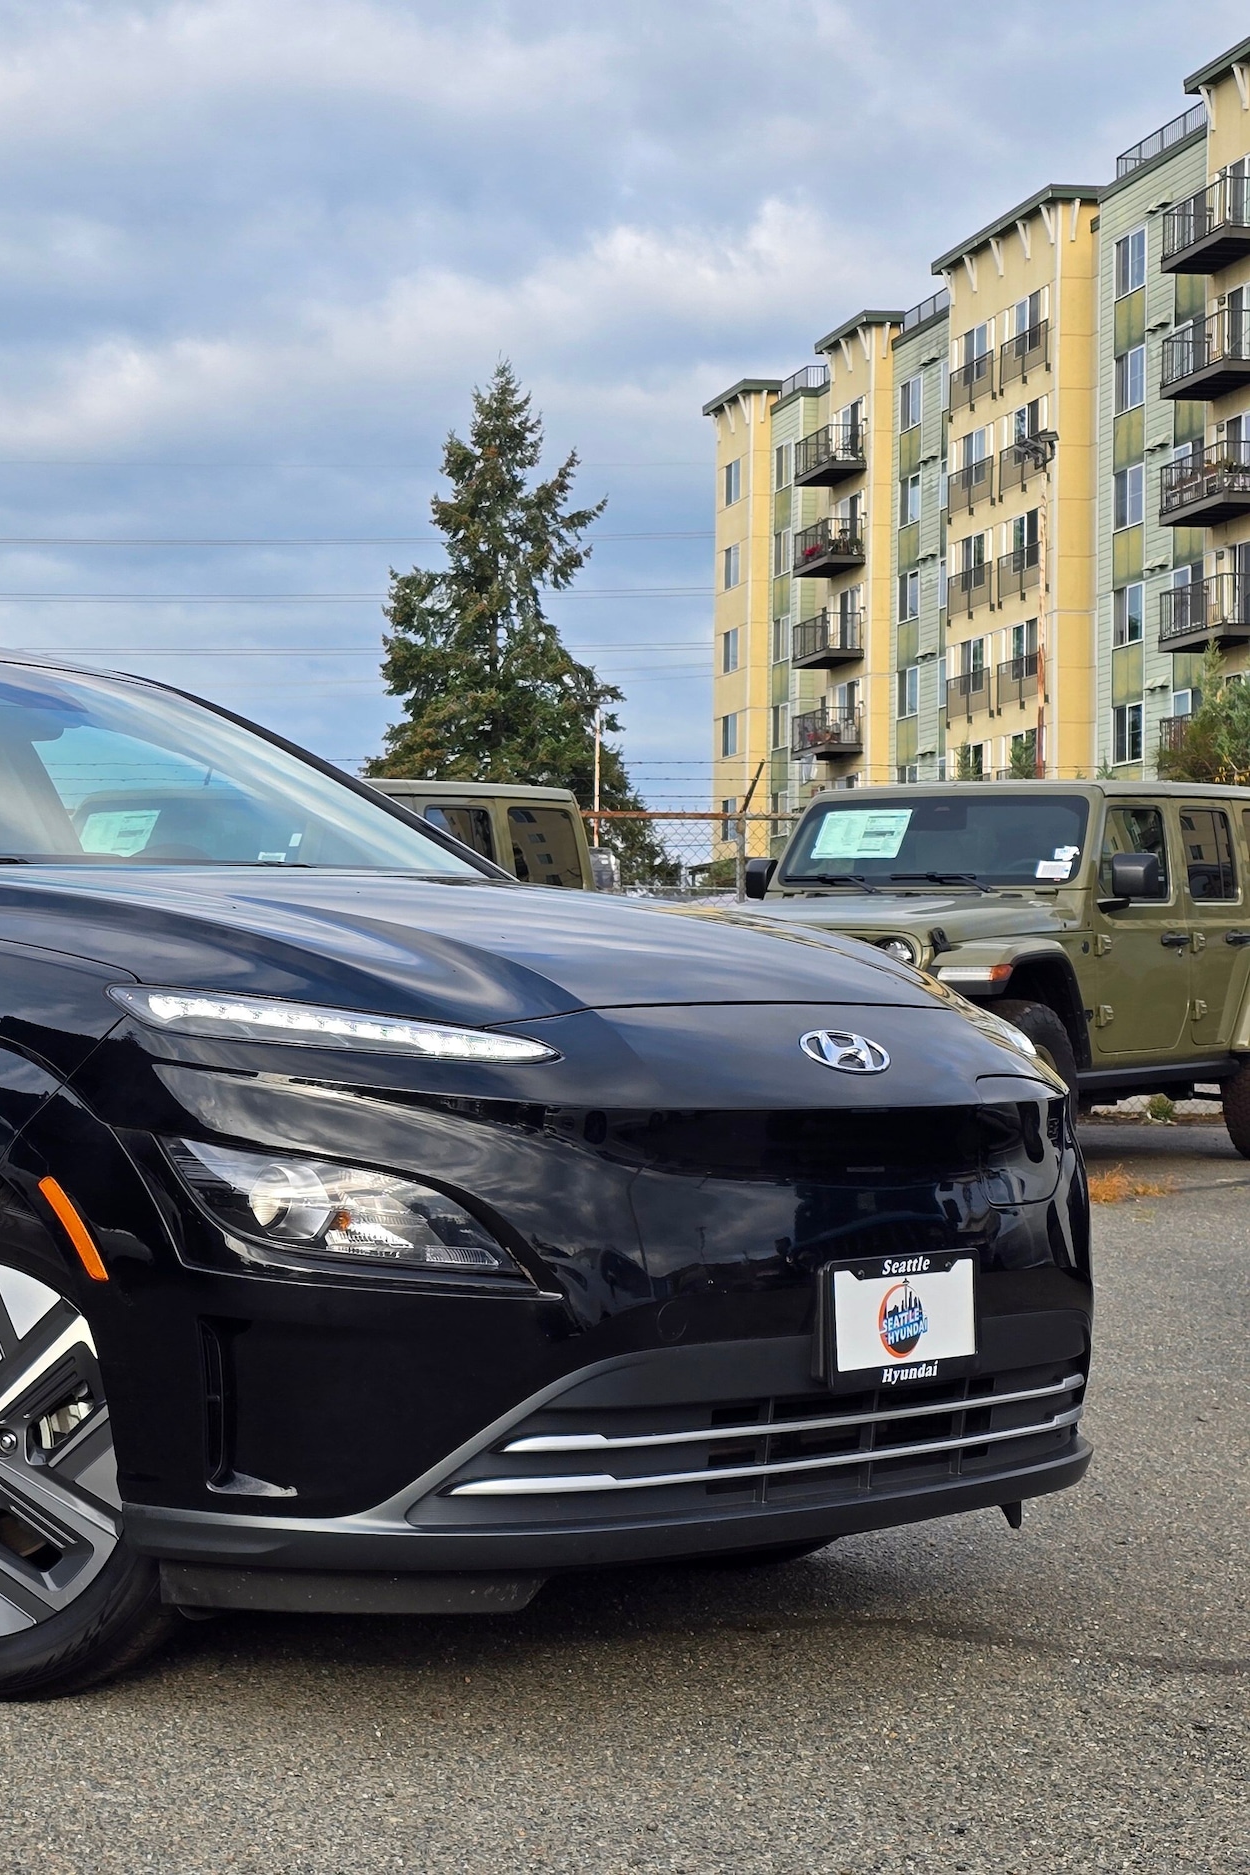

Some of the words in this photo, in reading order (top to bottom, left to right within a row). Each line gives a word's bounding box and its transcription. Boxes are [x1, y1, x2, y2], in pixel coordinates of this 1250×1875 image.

[882, 1256, 931, 1275] Seattle
[882, 1307, 920, 1333] SEATTLE
[887, 1317, 929, 1346] HYUNDAI
[882, 1360, 938, 1385] Hyundai
